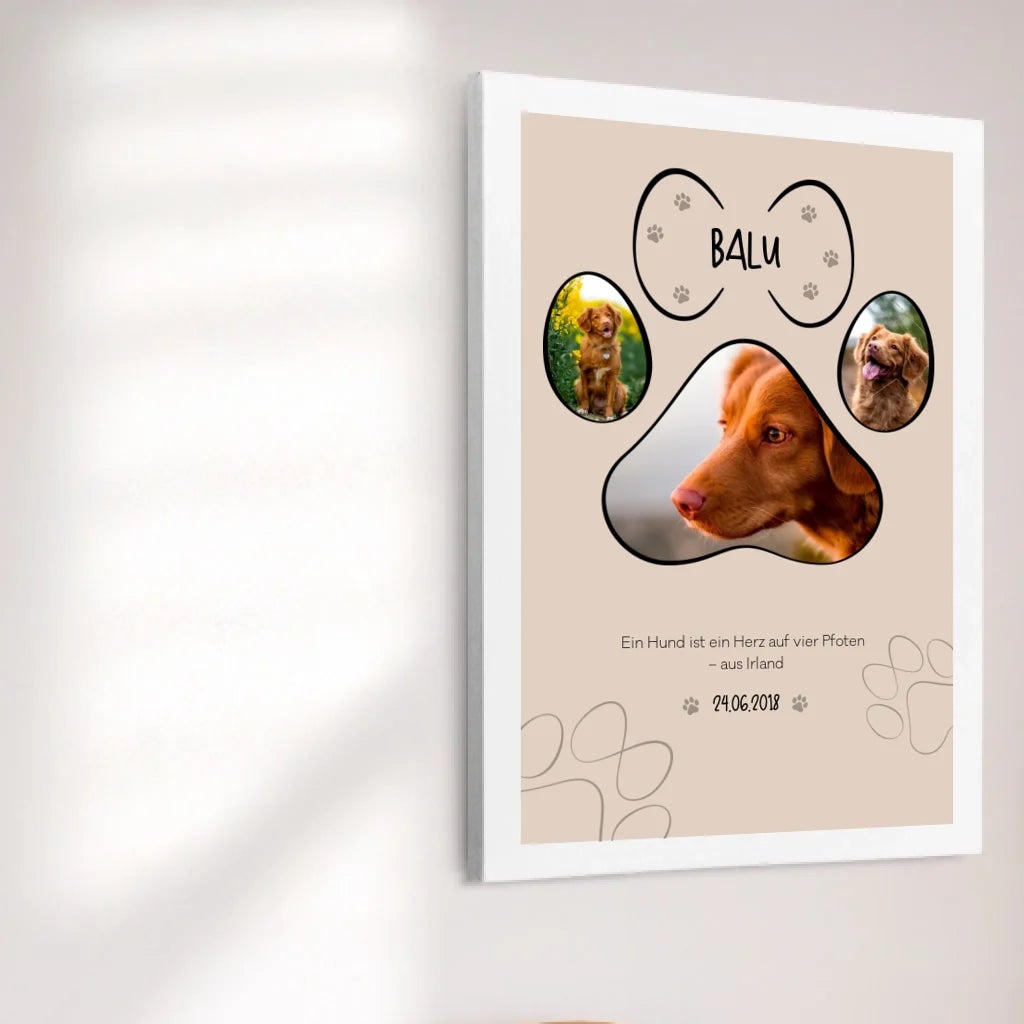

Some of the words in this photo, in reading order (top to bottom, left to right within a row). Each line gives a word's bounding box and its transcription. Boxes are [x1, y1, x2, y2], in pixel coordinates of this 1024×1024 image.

[710, 227, 781, 271] BALU
[621, 635, 644, 649] Ein
[647, 634, 686, 649] Hund
[689, 635, 706, 648] ist
[709, 635, 730, 648] ein
[733, 635, 766, 648] Herz
[768, 633, 790, 648] auf
[793, 635, 819, 648] vier
[822, 634, 865, 647] Pfoten
[720, 659, 743, 670] aus
[746, 656, 784, 670] Irland
[712, 693, 781, 713] 24.06.2018
